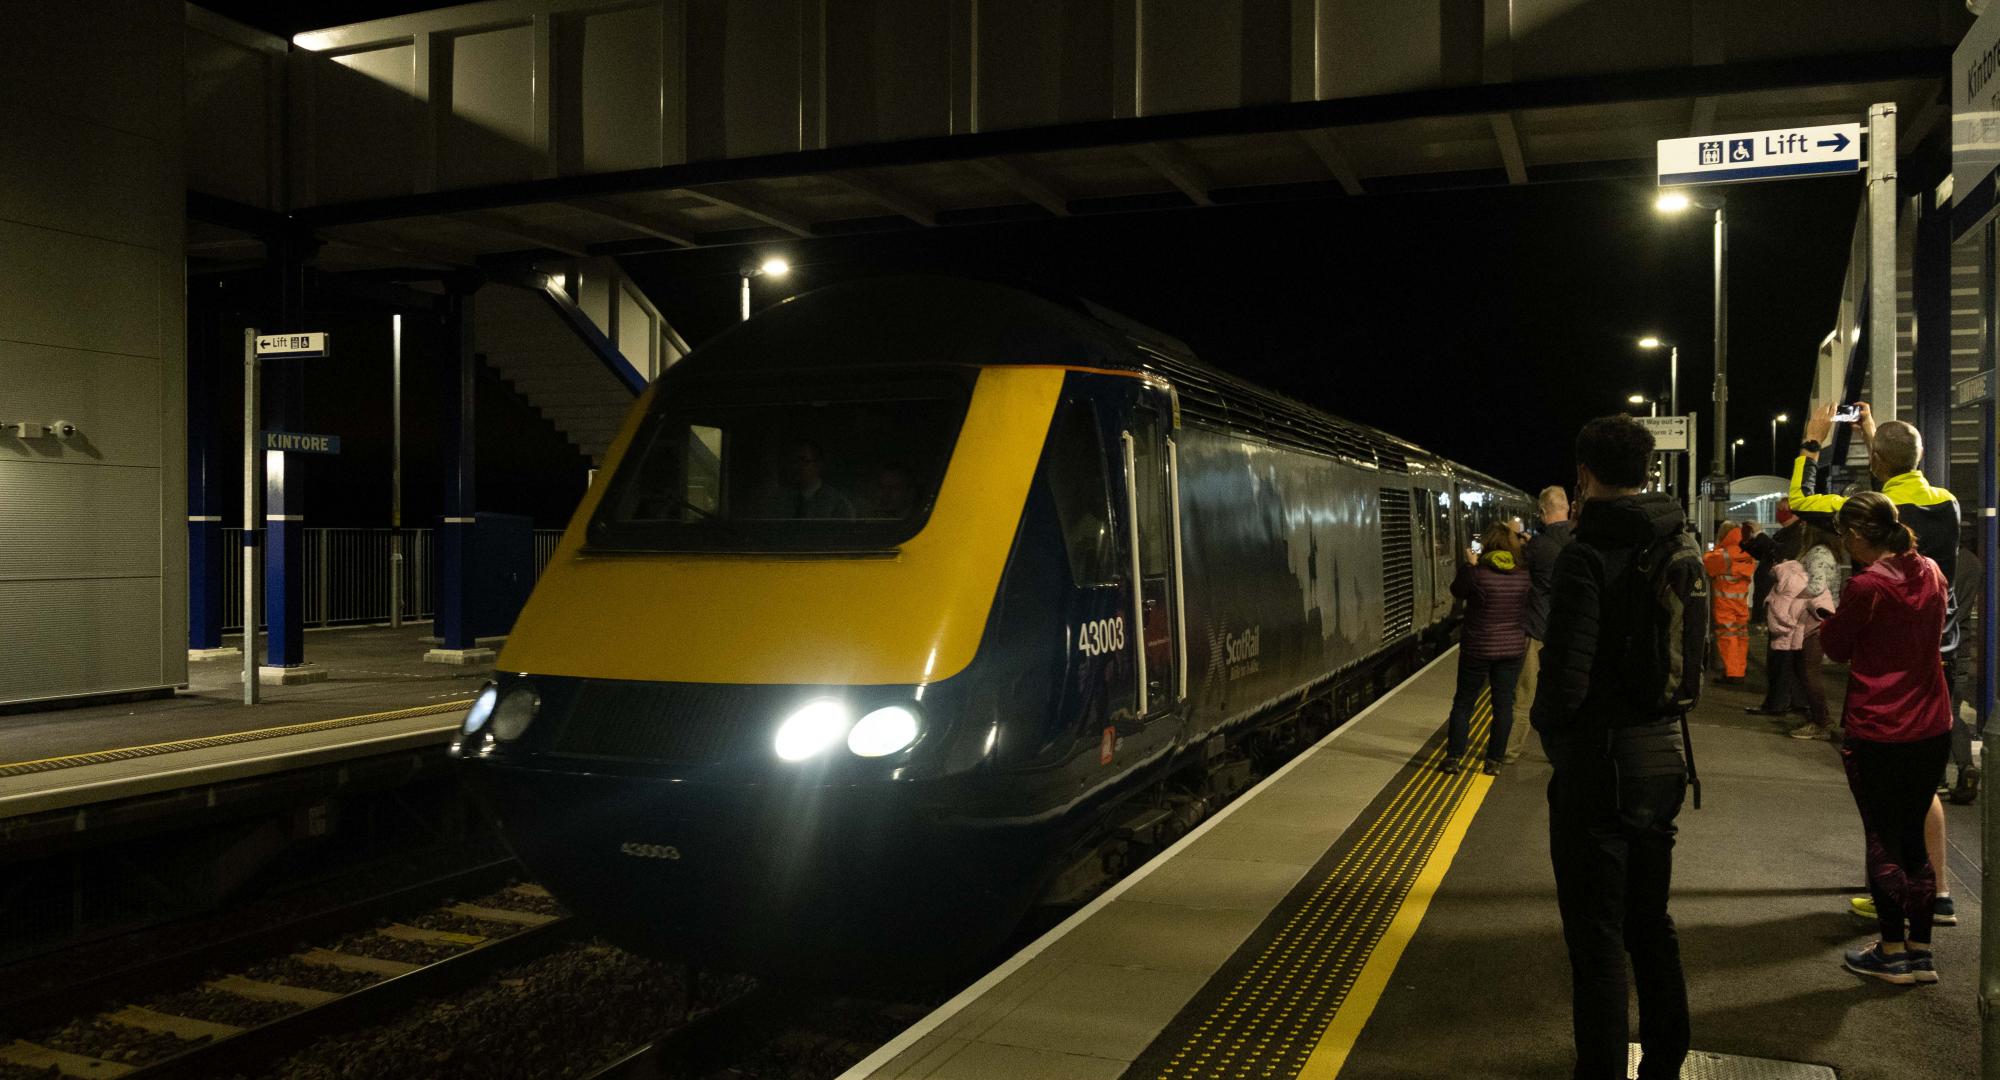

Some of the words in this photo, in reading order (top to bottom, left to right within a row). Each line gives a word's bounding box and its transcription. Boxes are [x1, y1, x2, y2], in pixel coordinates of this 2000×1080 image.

[1765, 133, 1808, 155] Lift
[272, 337, 287, 348] Lift
[266, 433, 329, 452] KINTORE
[1078, 616, 1125, 657] 43003
[1226, 624, 1260, 665] ScotRail
